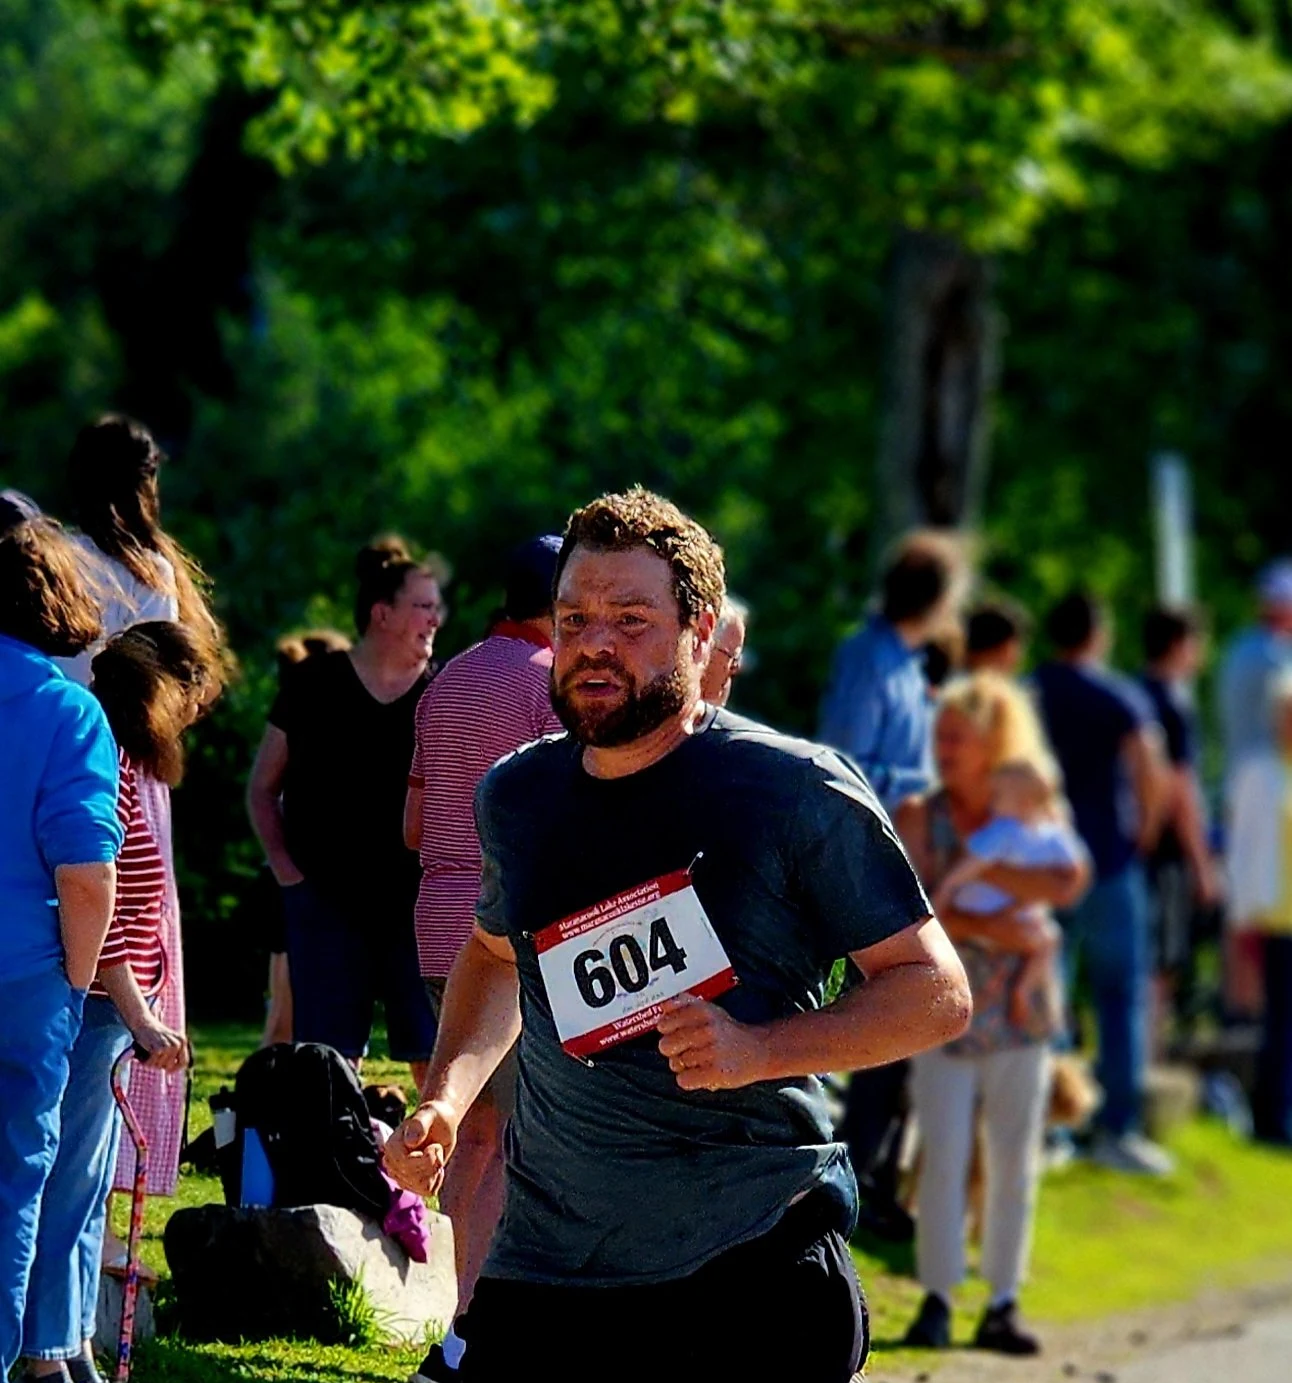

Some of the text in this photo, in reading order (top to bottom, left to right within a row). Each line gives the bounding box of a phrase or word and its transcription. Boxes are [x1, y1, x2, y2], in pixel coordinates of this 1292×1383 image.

[600, 899, 617, 913] Lake
[617, 881, 660, 905] Association
[573, 916, 688, 1008] 604
[612, 1007, 653, 1030] Watershed
